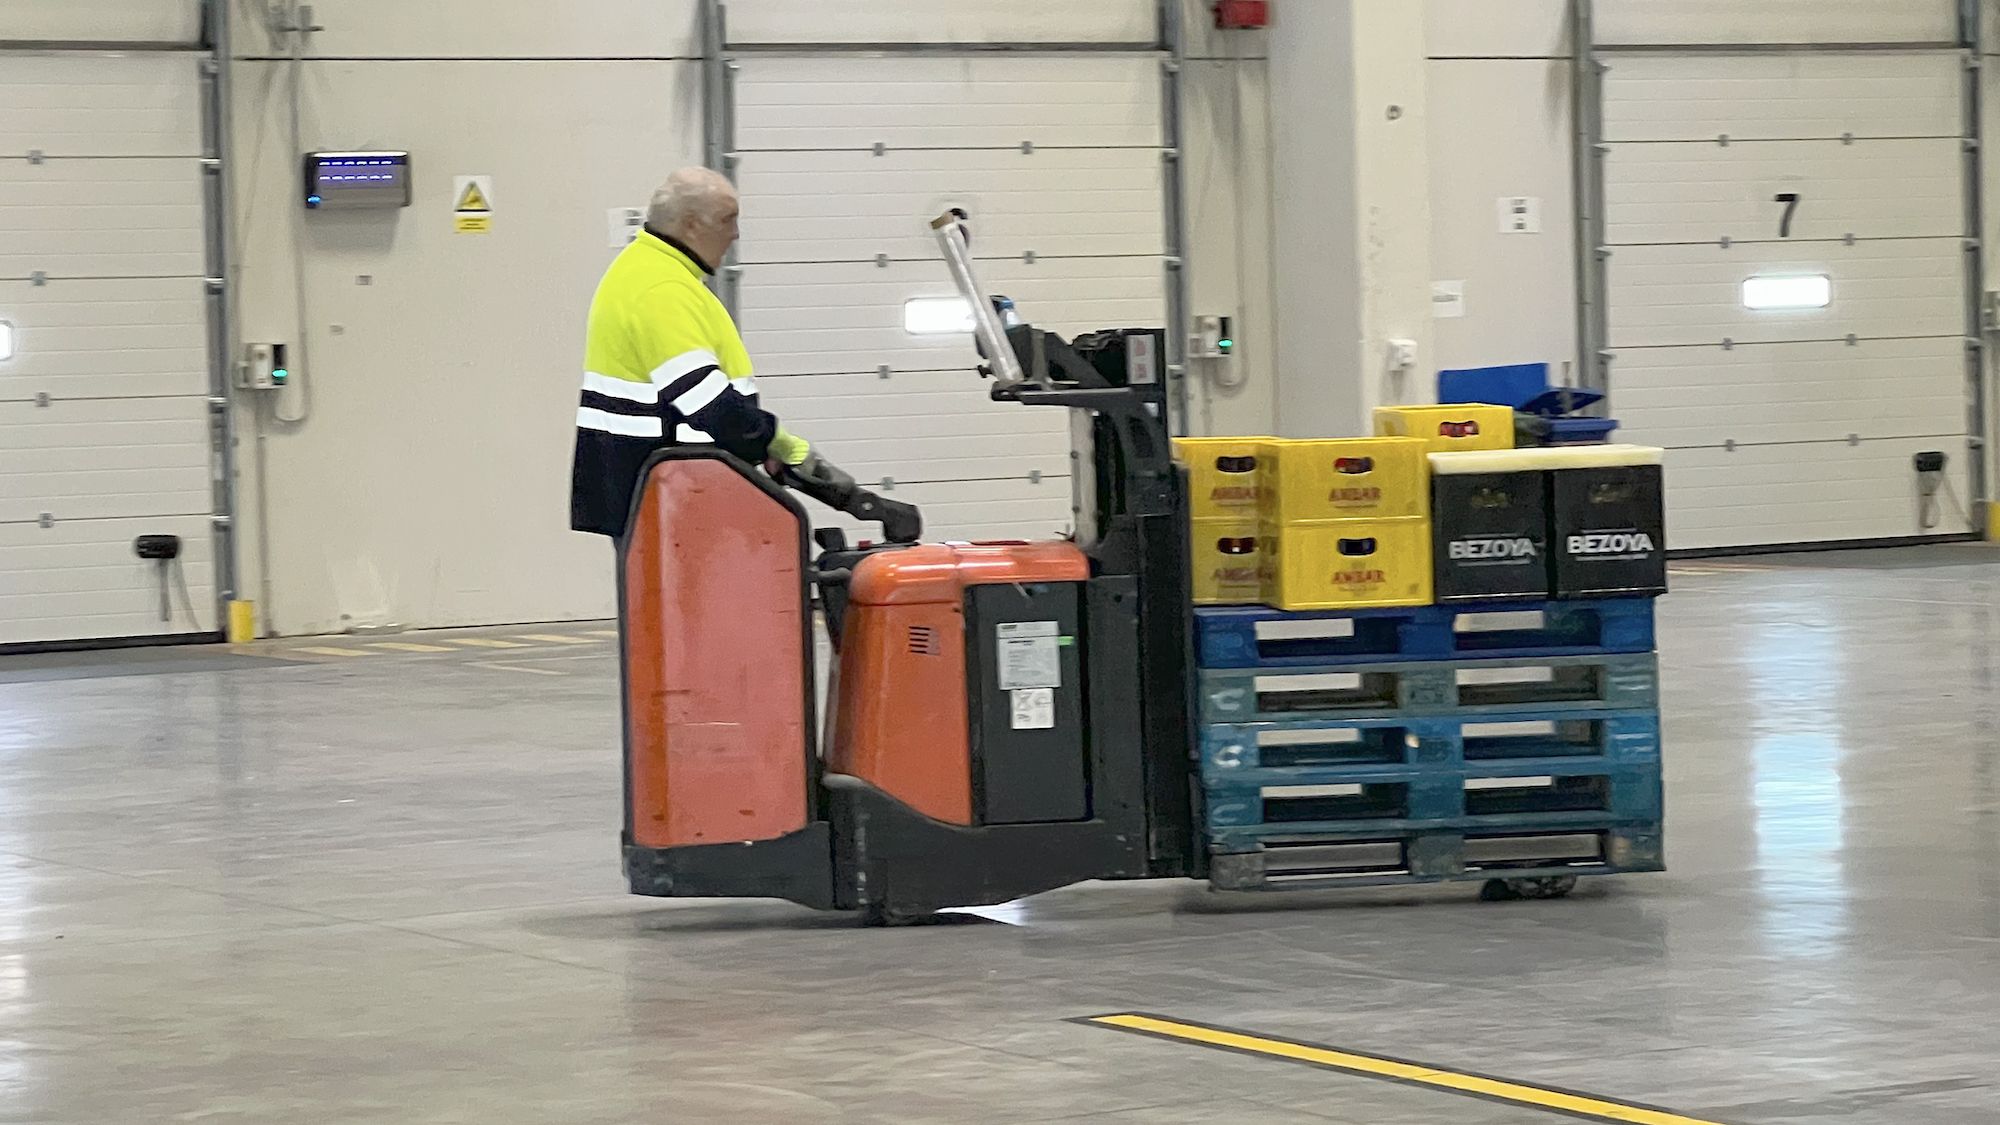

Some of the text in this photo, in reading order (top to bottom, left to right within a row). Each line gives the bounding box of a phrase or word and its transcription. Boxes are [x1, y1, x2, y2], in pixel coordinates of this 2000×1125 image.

[1775, 193, 1801, 238] 7
[1449, 538, 1537, 560] BEZOYA
[1567, 533, 1655, 554] BEZOYA
